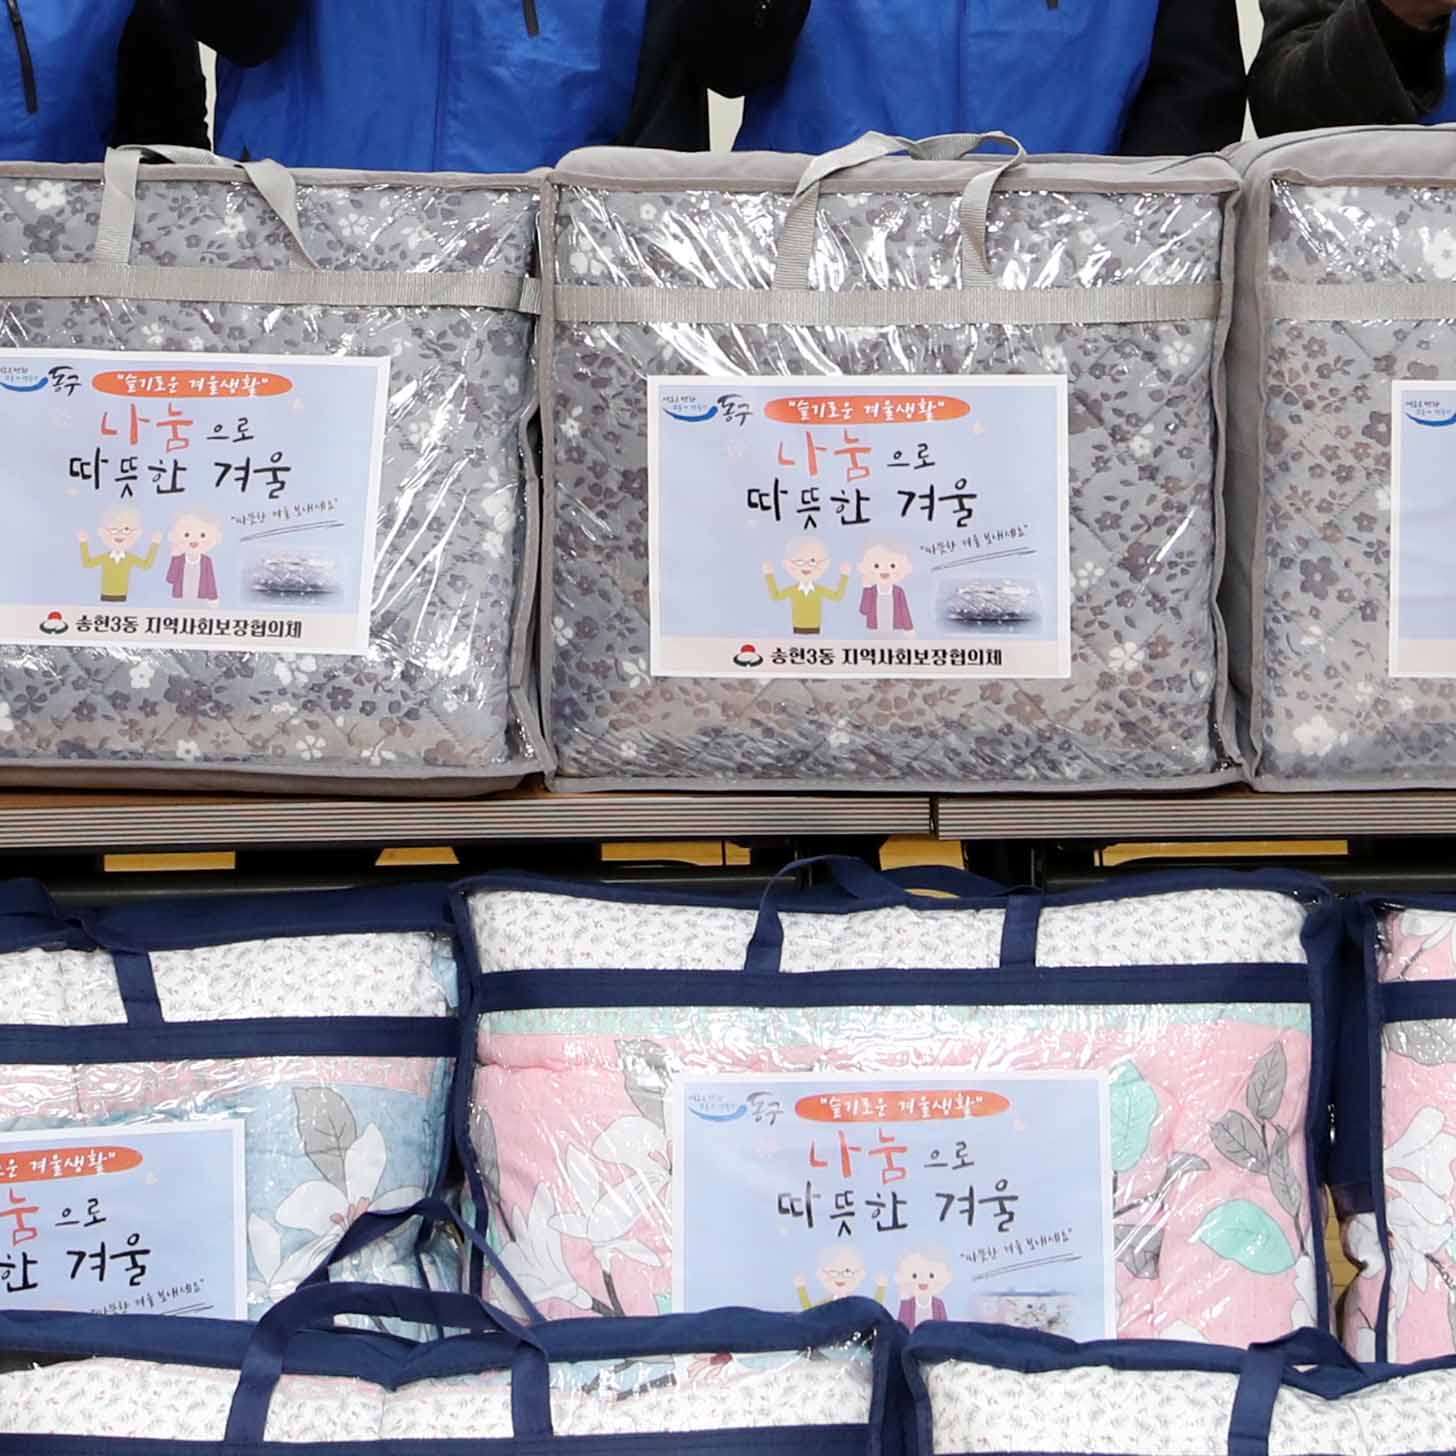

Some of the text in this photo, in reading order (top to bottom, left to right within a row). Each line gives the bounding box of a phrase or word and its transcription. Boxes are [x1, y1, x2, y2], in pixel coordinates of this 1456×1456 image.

[48, 365, 81, 396] 동구
[717, 394, 752, 425] 동구
[69, 447, 291, 499] 따뜻한 겨울
[747, 478, 978, 530] 따뜻한 겨울
[75, 616, 302, 638] 송현3동 지역사회보장협의체
[771, 647, 1002, 666] 송현3동 지역사회보장협의체
[746, 1091, 784, 1126] 동구
[778, 1179, 1019, 1237] 따뜻한 겨울
[66, 1233, 151, 1287] 겨울
